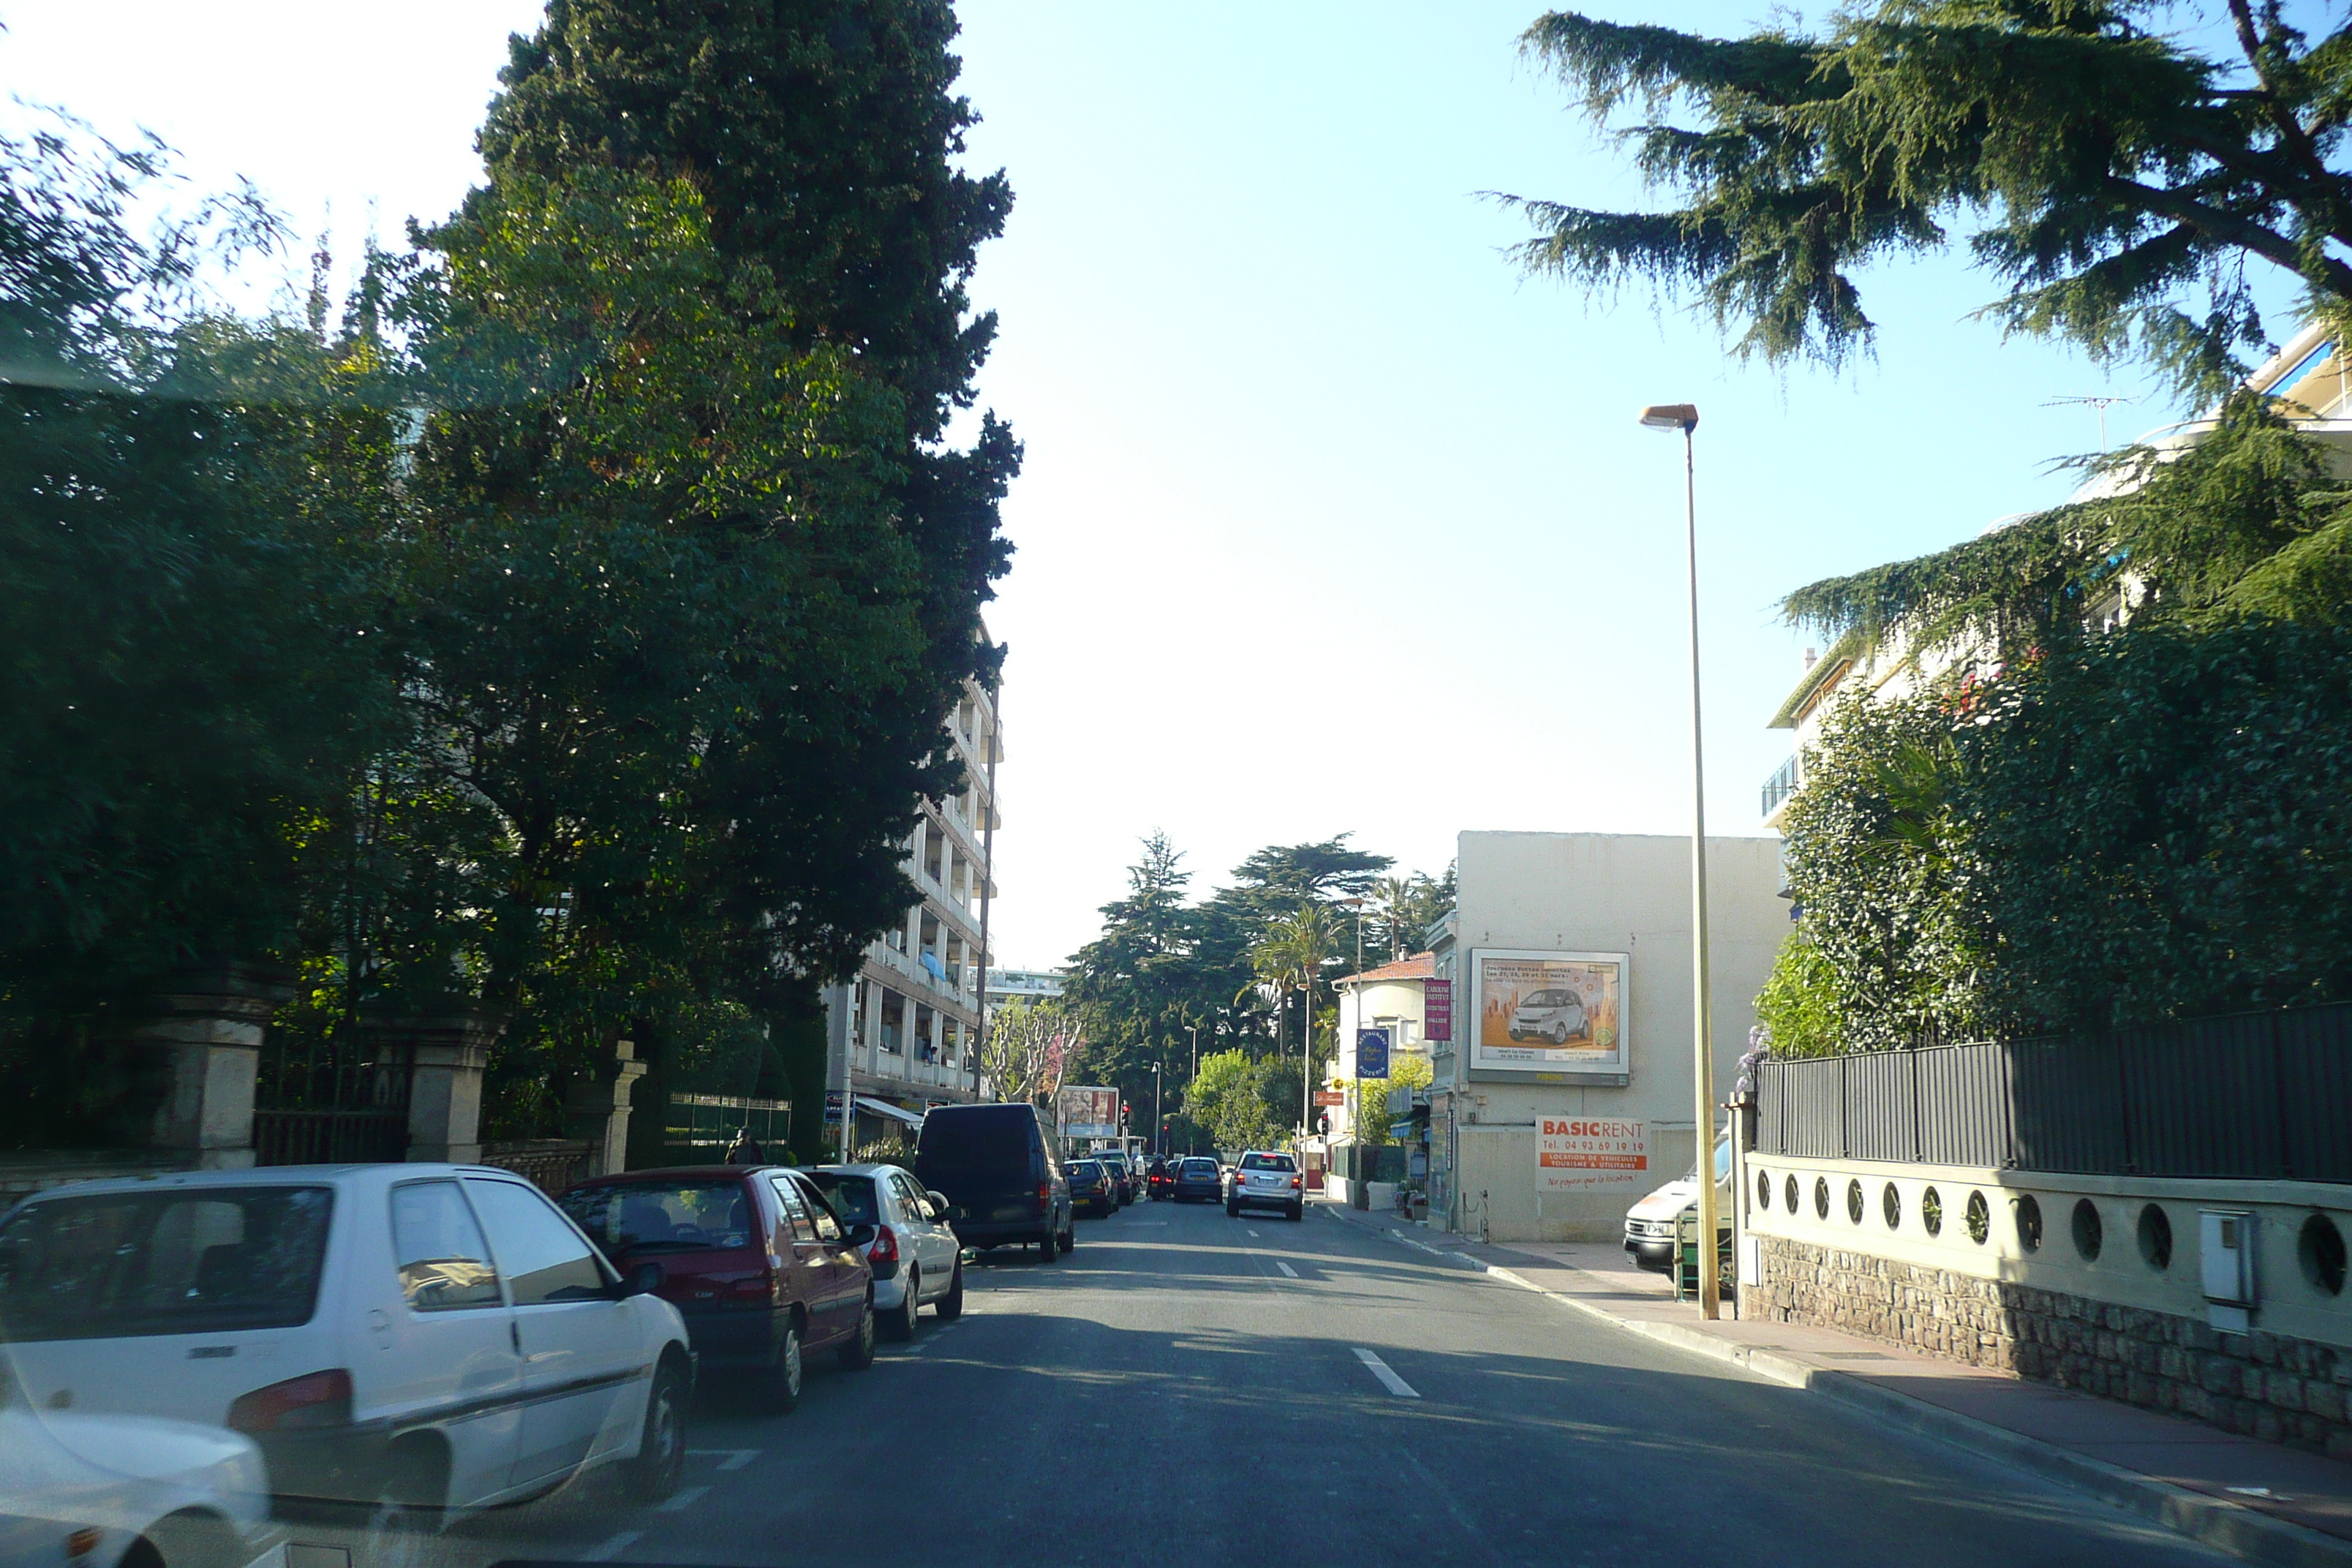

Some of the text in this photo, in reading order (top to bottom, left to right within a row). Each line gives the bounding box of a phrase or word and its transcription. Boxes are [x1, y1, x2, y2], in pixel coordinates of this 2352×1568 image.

[1358, 1031, 1387, 1045] RESTAURANT
[1359, 1065, 1386, 1076] PIZZERIA
[1565, 1141, 1576, 1150] 04
[1582, 1142, 1594, 1150] 93
[1599, 1142, 1610, 1150] 69
[1616, 1142, 1627, 1151] 19
[1633, 1142, 1643, 1152] 19
[1548, 1177, 1558, 1186] Ne
[1583, 1177, 1597, 1189] que
[1598, 1174, 1605, 1183] la
